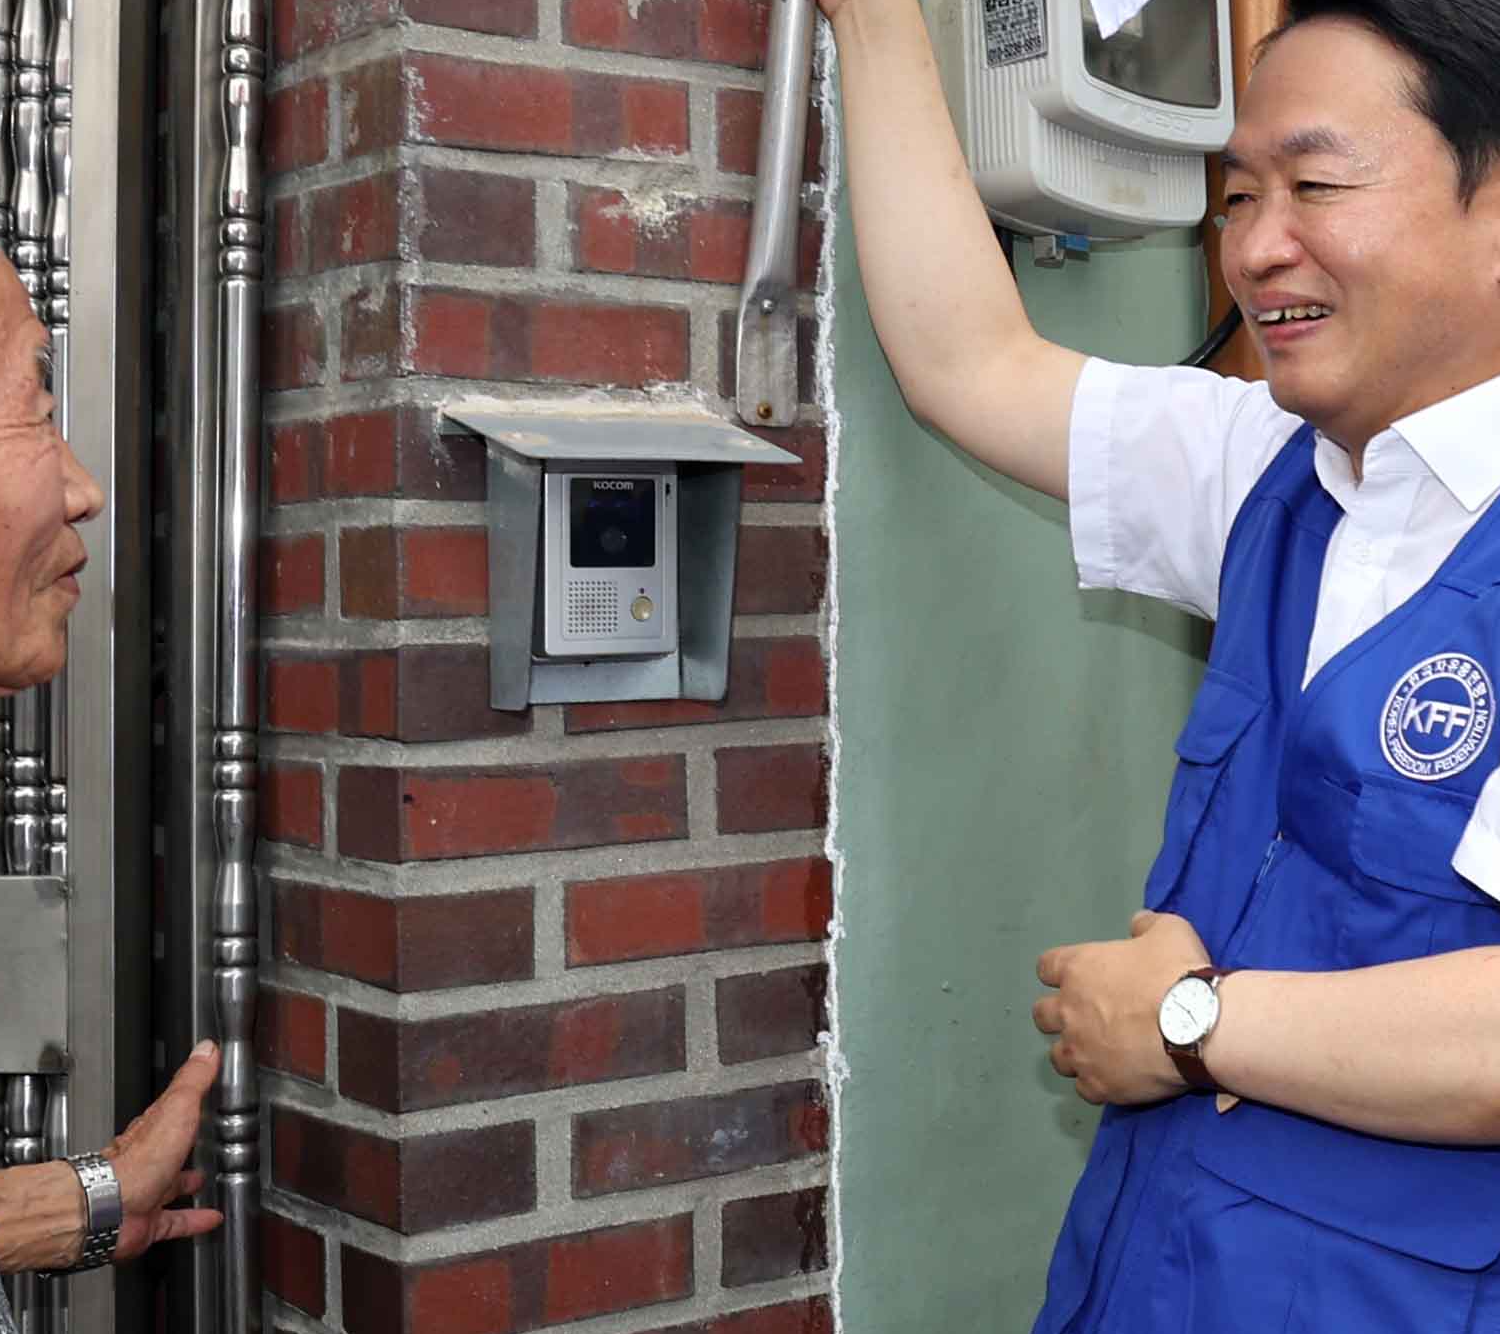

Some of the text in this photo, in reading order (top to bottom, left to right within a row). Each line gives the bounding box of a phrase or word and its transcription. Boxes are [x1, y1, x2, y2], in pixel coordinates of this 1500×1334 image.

[1387, 696, 1488, 775] KOREA FREEDOM FEDERATION
[1403, 698, 1472, 739] KFF
